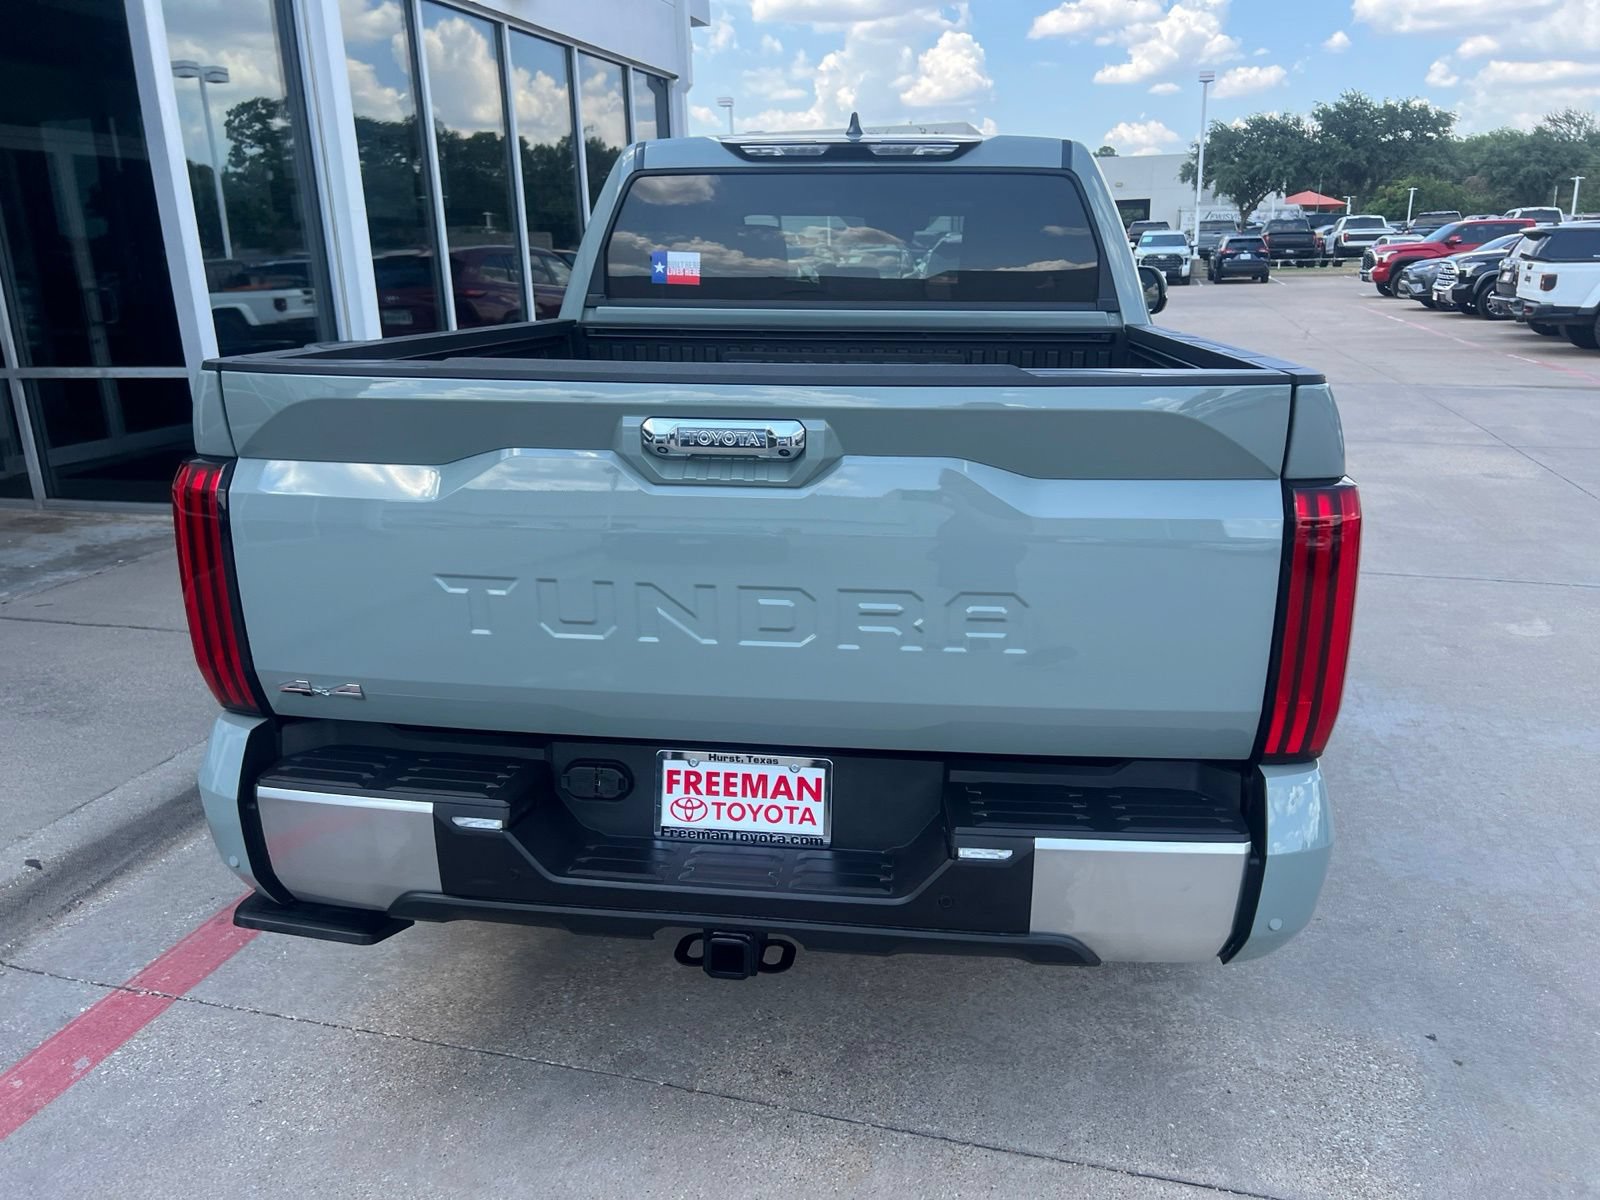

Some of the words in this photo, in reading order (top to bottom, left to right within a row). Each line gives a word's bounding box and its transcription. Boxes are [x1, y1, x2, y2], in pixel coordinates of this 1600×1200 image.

[686, 430, 761, 447] TOYOTA
[433, 573, 1029, 655] TUNDRA
[708, 753, 744, 763] Hurst,
[746, 756, 779, 765] Texas
[666, 769, 823, 802] FREEMAN
[711, 801, 817, 826] TOYOTA
[661, 826, 824, 846] FreemanToyota.com
